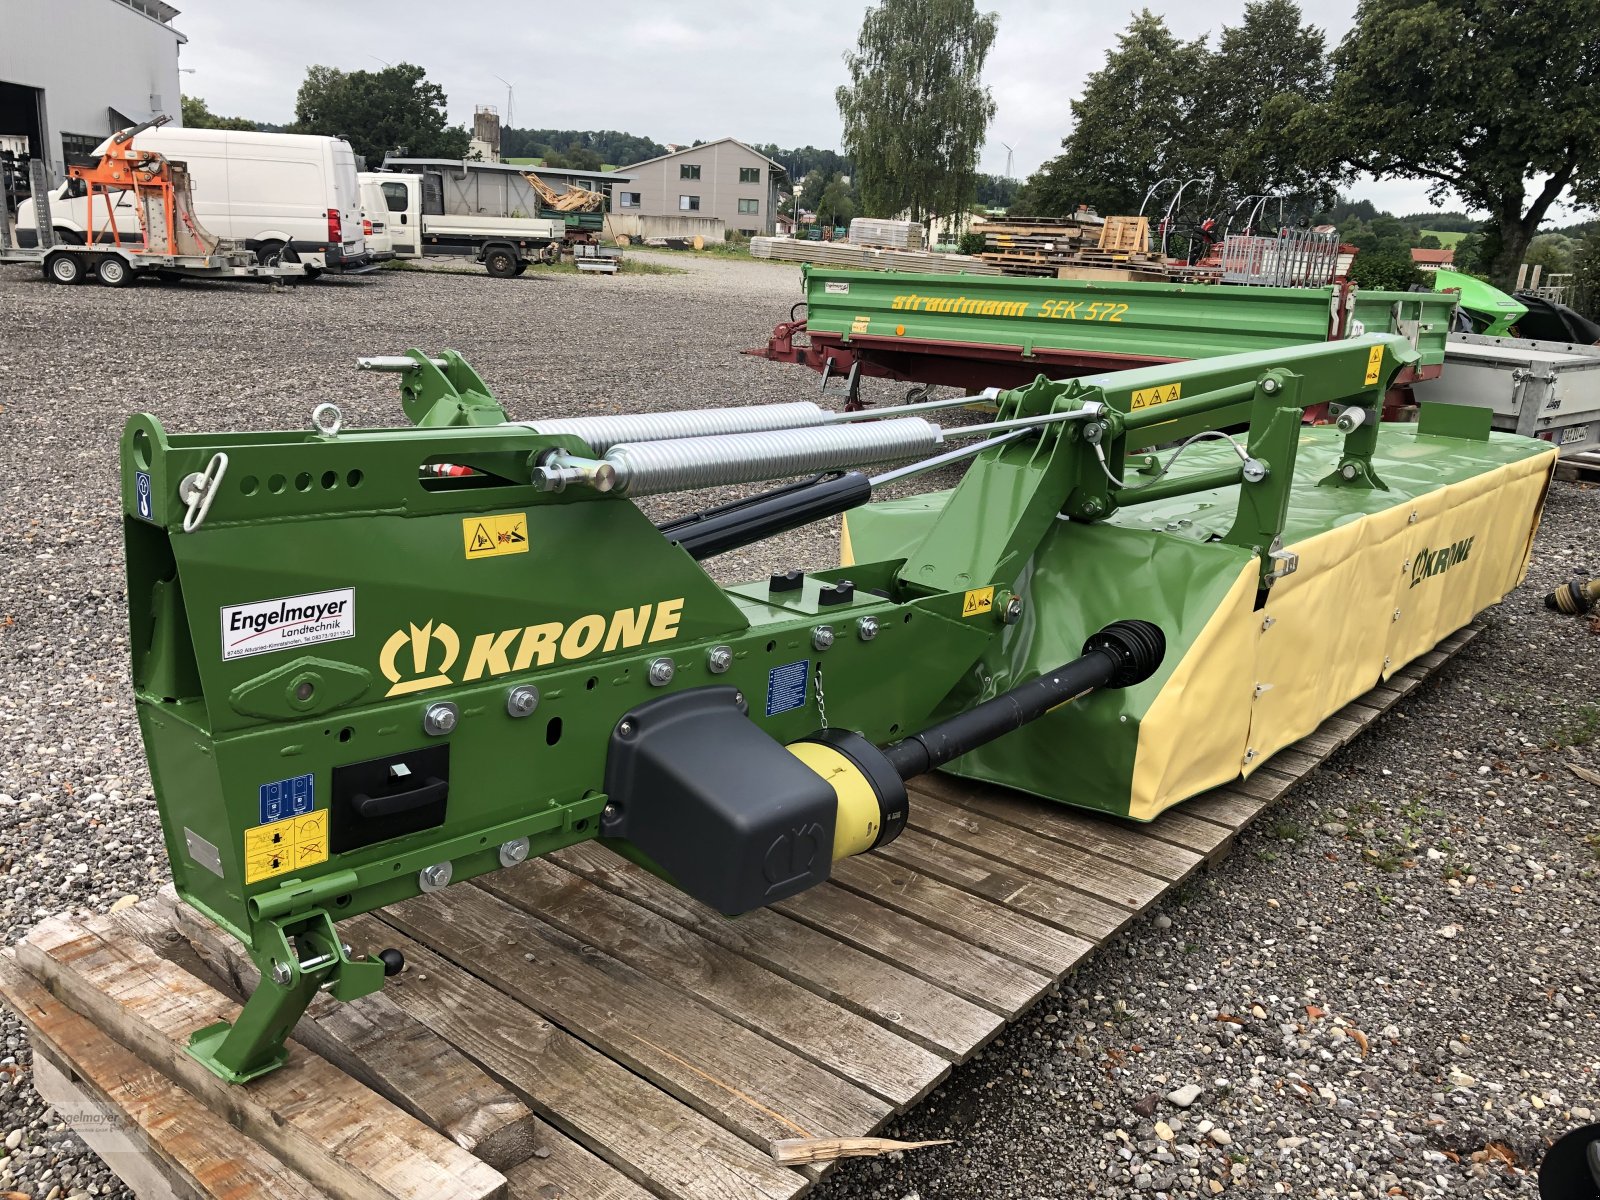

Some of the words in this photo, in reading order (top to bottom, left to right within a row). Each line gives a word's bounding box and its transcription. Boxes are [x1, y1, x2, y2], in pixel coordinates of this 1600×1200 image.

[891, 294, 1030, 318] strautmann
[1037, 299, 1084, 320] SEK
[1083, 302, 1130, 322] 572
[1423, 535, 1475, 580] KRONE
[230, 600, 347, 633] Engelmayer
[281, 620, 341, 638] Landtechnik
[462, 597, 685, 682] KRONE
